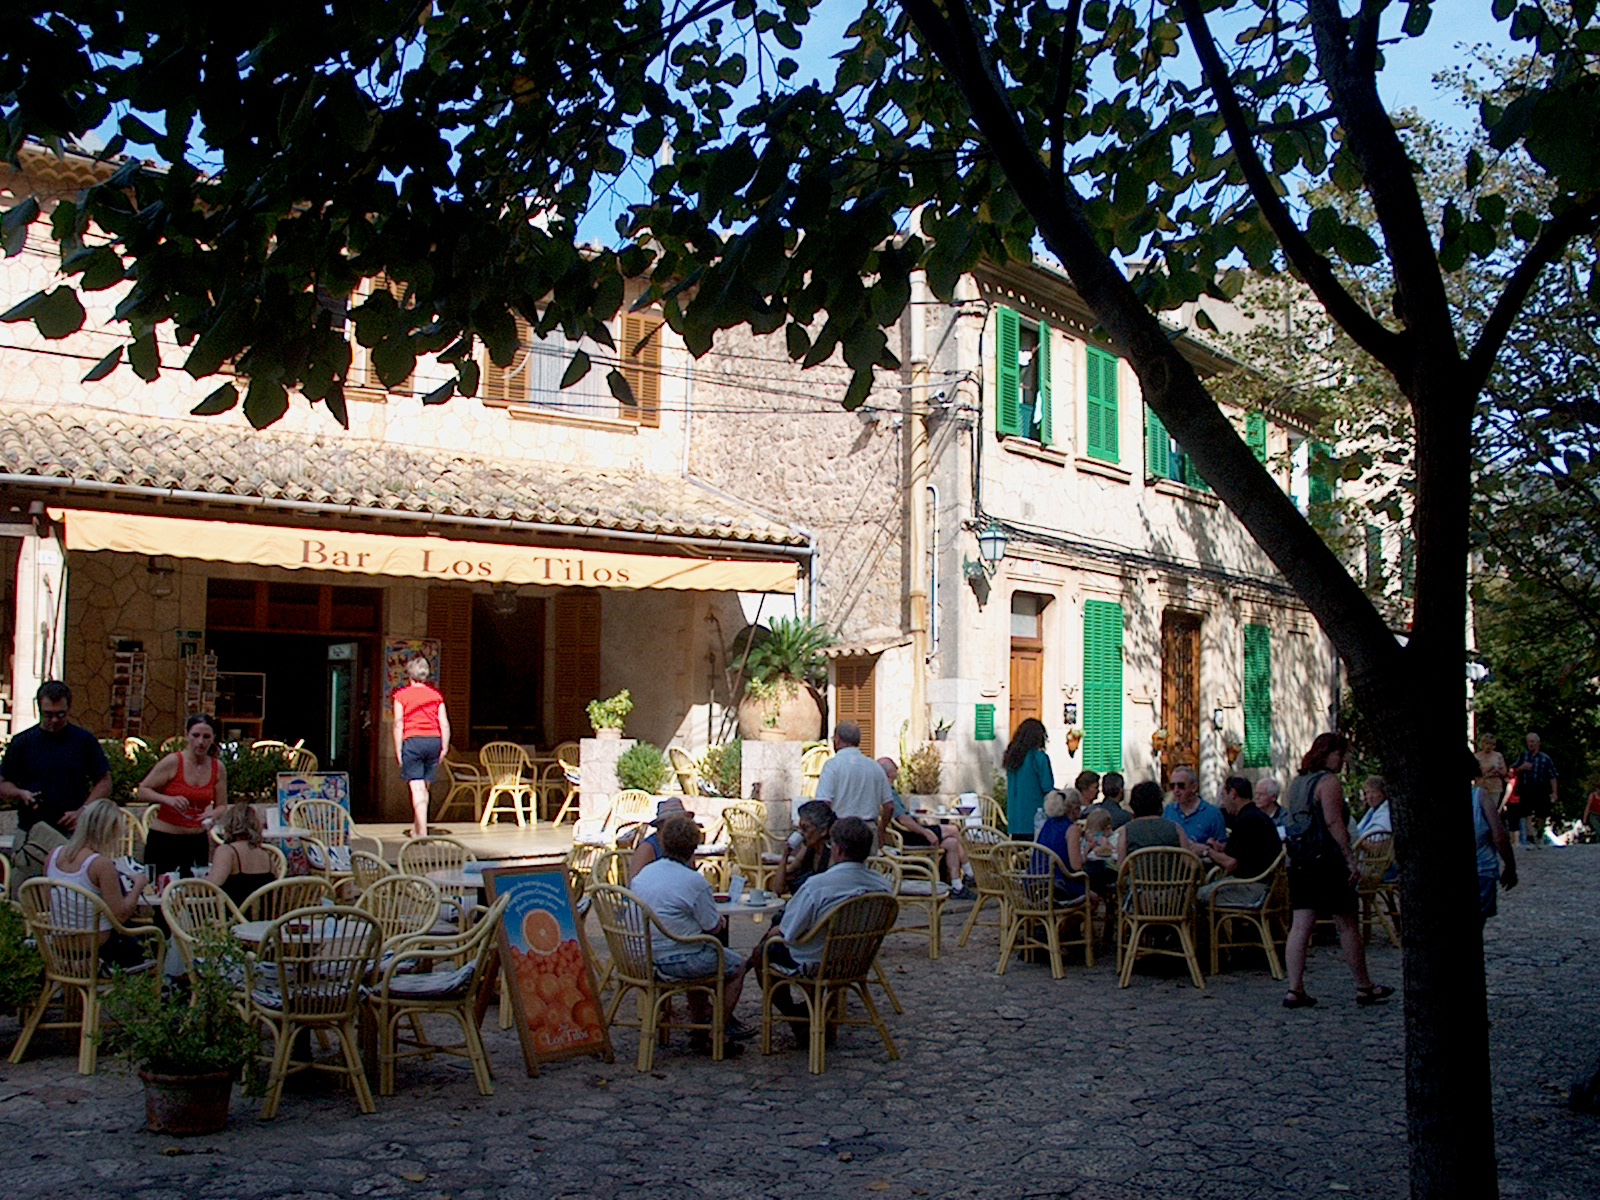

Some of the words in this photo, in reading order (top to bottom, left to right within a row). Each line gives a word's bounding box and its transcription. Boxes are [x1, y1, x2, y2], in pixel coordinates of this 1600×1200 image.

[299, 539, 370, 568] Bar
[421, 549, 492, 577] Los
[533, 556, 630, 583] Tilos
[545, 1033, 564, 1046] Los
[566, 1029, 589, 1043] Tilos
